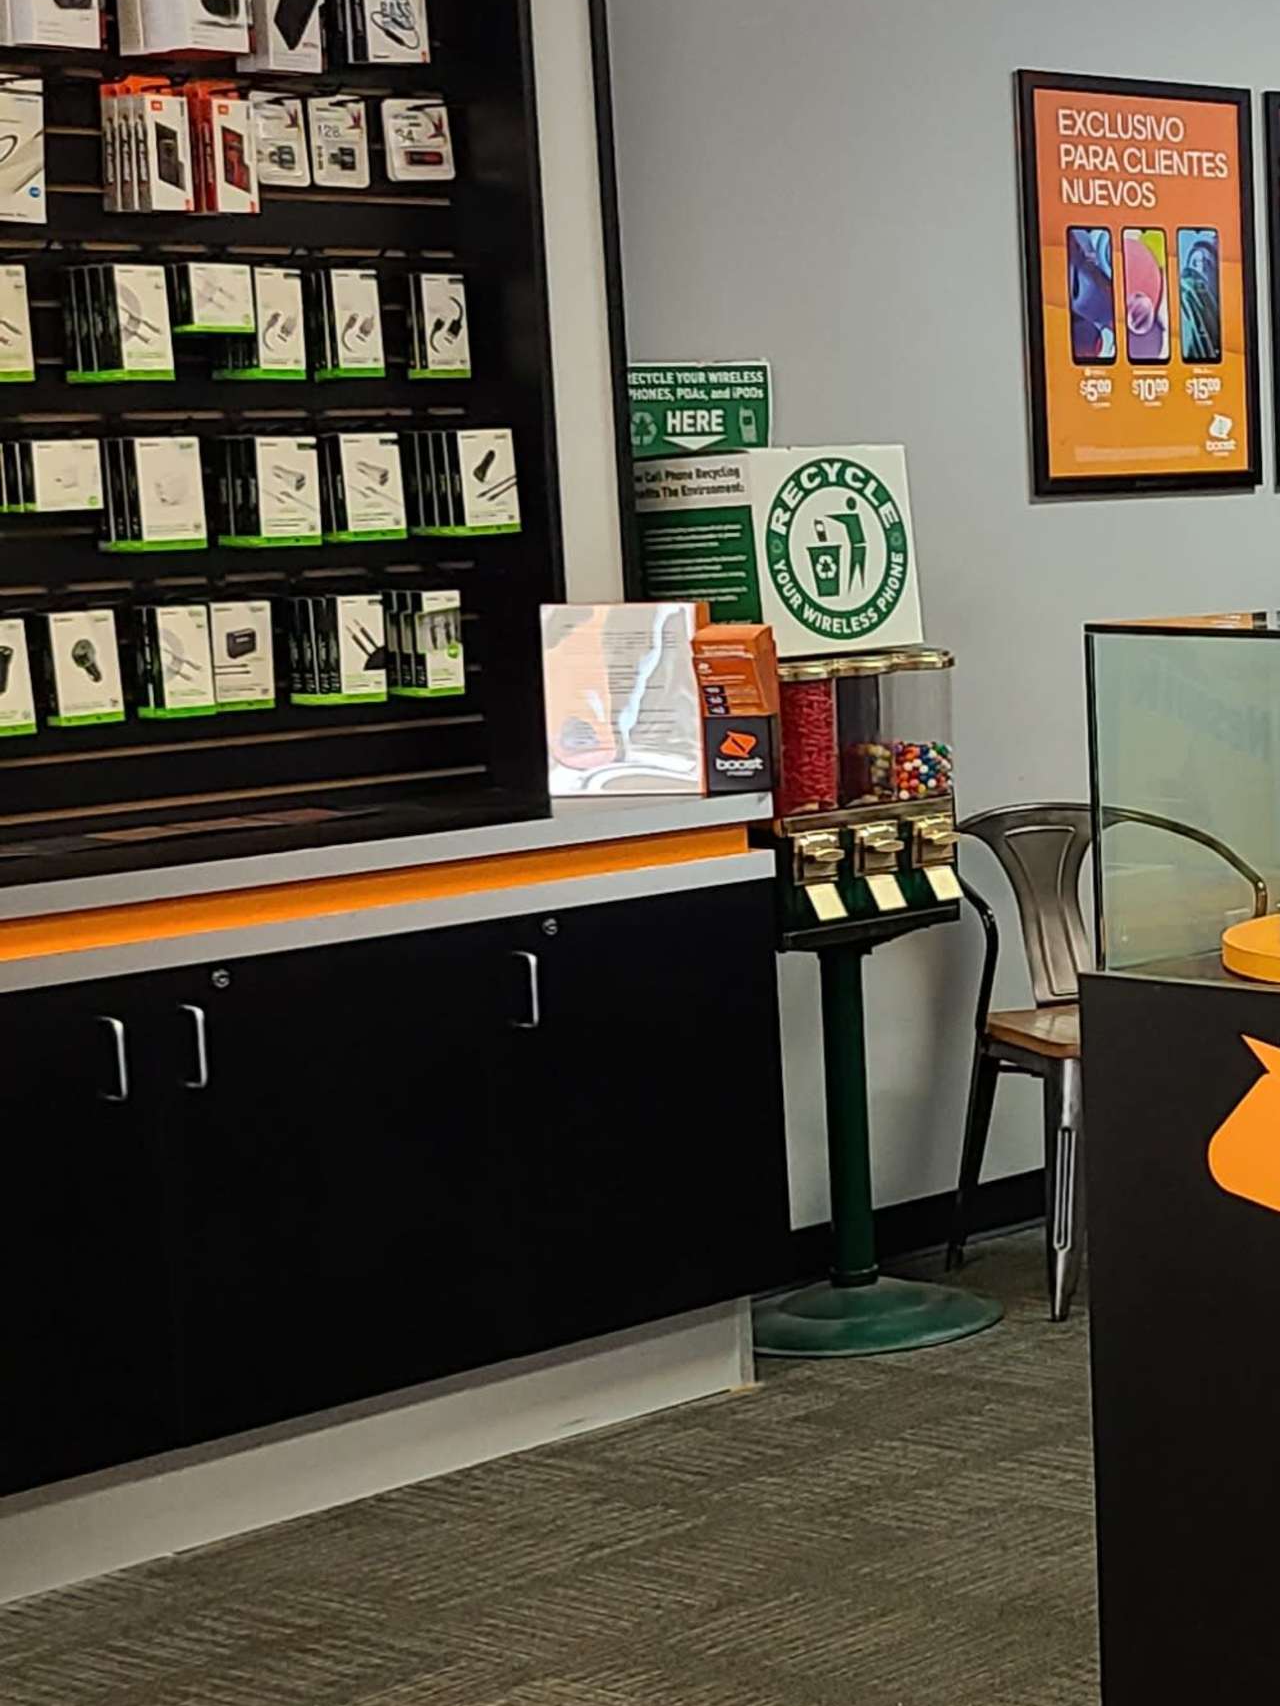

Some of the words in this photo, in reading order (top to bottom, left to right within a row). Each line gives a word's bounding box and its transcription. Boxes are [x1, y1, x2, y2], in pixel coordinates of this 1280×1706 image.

[1058, 109, 1185, 142] EXCLUSIVO
[1060, 143, 1119, 172] PARA
[1123, 147, 1229, 178] CLIENTES
[1061, 178, 1156, 207] NUEVOS
[676, 372, 706, 384] YOUR
[707, 371, 764, 383] WIRELESS
[711, 388, 730, 399] and
[666, 409, 724, 433] HERE
[770, 462, 900, 535] RECYCLE
[773, 560, 803, 610] YOUR
[802, 604, 878, 634] WIRELESS
[876, 551, 904, 612] PHONE
[716, 757, 763, 770] boost
